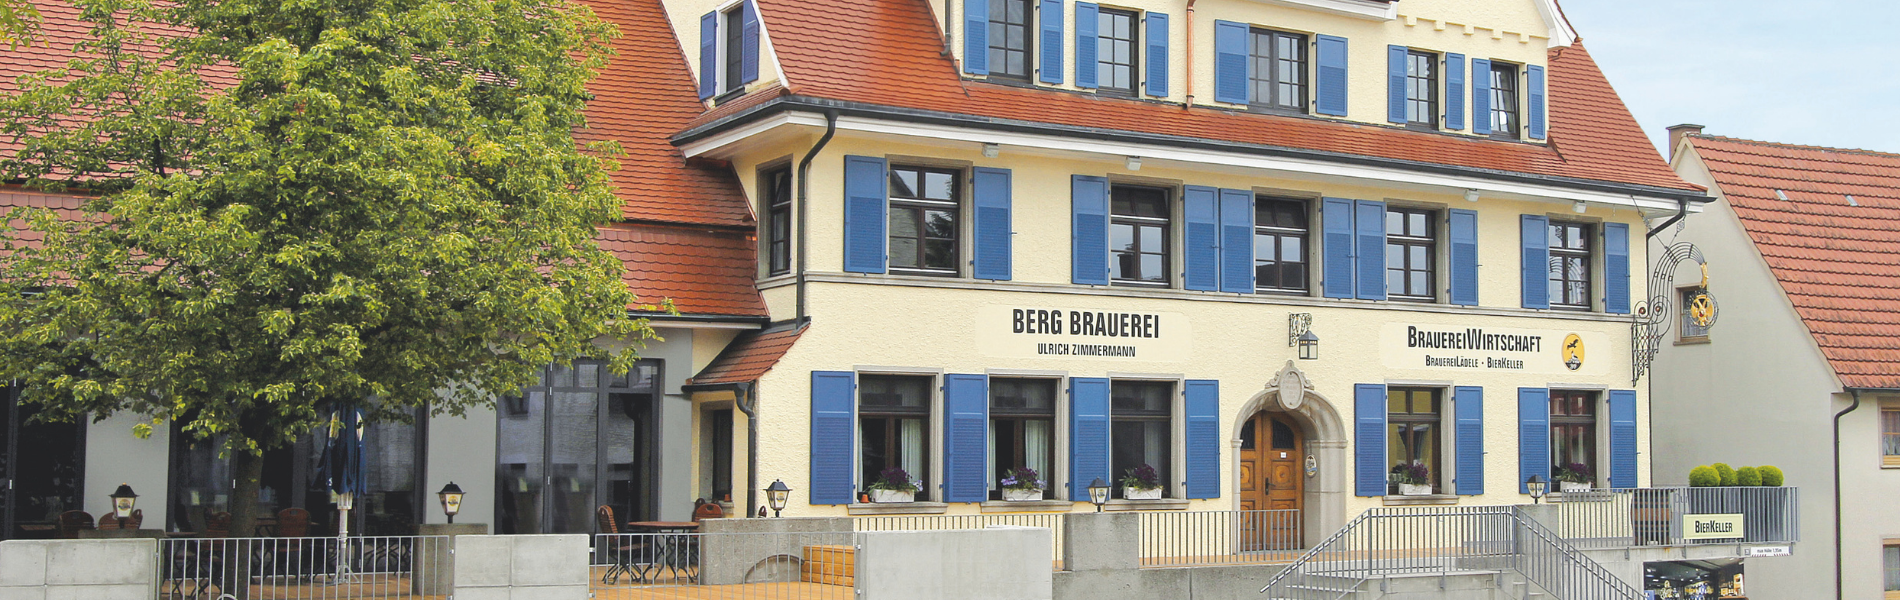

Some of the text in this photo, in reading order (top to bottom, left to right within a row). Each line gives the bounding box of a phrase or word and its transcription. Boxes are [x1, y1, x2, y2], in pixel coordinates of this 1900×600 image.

[1012, 308, 1160, 339] BERG BRAUEREI
[1037, 343, 1136, 357] ULRICH ZIMMERMANN
